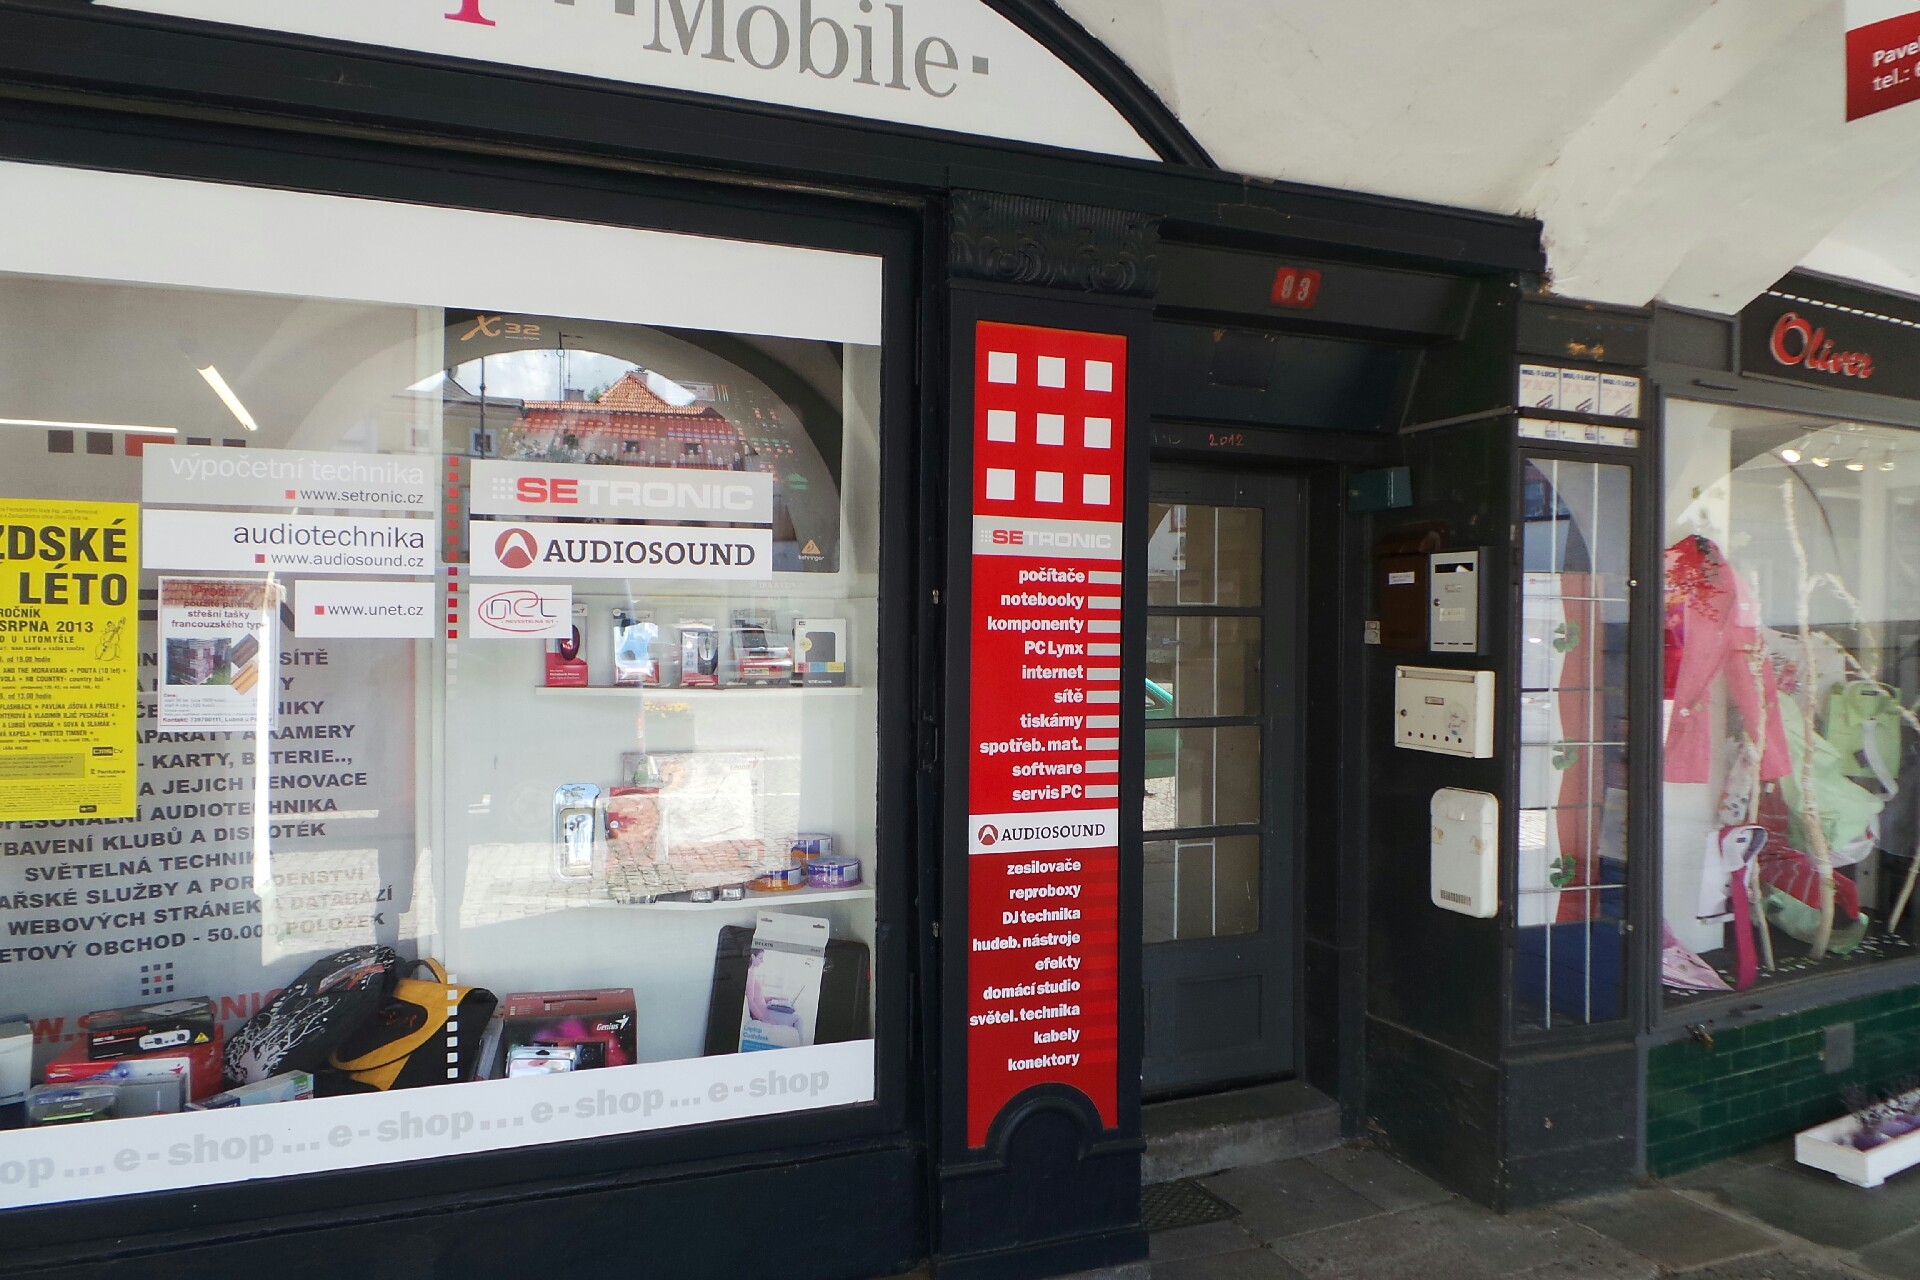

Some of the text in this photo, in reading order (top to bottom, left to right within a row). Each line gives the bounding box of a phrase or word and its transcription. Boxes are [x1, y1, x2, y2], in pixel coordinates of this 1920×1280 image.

[642, 0, 959, 98] Mobile
[1872, 67, 1910, 91] tel.:
[1208, 433, 1244, 446] 2012
[171, 452, 424, 485] výpočetní technika
[300, 489, 424, 504] www.setronic.cz
[516, 476, 753, 510] SETRONIC
[0, 518, 127, 562] DSKÉ
[233, 523, 424, 549] audiotechnika
[992, 529, 1112, 549] SETRONIC
[271, 553, 424, 568] www.audiosound.cz
[543, 538, 756, 567] AUDIOSOUND
[19, 563, 127, 605] LÉTO
[1018, 567, 1085, 584] počítače
[328, 604, 423, 615] www.unet.cz
[1000, 592, 1085, 609] notebooky
[188, 609, 250, 619] střešní tašky
[56, 621, 93, 633] 2013
[171, 620, 266, 631] francouzského typ
[987, 616, 1084, 633] komponenty
[1024, 640, 1084, 658] PC Lynx
[1022, 665, 1083, 679] internet
[1054, 688, 1083, 703] sítě
[1020, 713, 1083, 729] tiskárny
[979, 737, 1083, 755] spotřeb. mat.
[242, 749, 352, 767] BTERIE..,
[1012, 762, 1083, 777] software
[162, 777, 244, 795] JEJICH
[252, 772, 367, 790] ENOVACE
[1012, 784, 1082, 801] servis PC
[150, 798, 338, 821] AUDIOTEHNIKA
[102, 826, 182, 851] KLUBŮ
[190, 829, 206, 844] A
[214, 821, 326, 843] DISOTÉK
[1001, 823, 1106, 842] AUDIOSOUND
[25, 849, 274, 882] SVĚTELNÁ TECHNI
[1006, 858, 1081, 875] zesilovače
[86, 882, 179, 905] SLUŽBY
[186, 879, 202, 895] A
[210, 866, 363, 892] PORDENSTVÍ
[1009, 884, 1081, 900] reproboxy
[8, 911, 145, 936] WEBOVÝCH
[153, 900, 261, 924] STRÁNEK
[1002, 907, 1081, 925] DJ technika
[85, 932, 186, 957] OBCHOD
[972, 931, 1080, 951] hudeb. nástroje
[1035, 955, 1080, 970] efekty
[983, 979, 1080, 1000] domácí studio
[969, 1003, 1080, 1026] světel. technika
[596, 1023, 619, 1031] Genius
[1034, 1028, 1080, 1044] kabely
[1008, 1053, 1080, 1071] konektory
